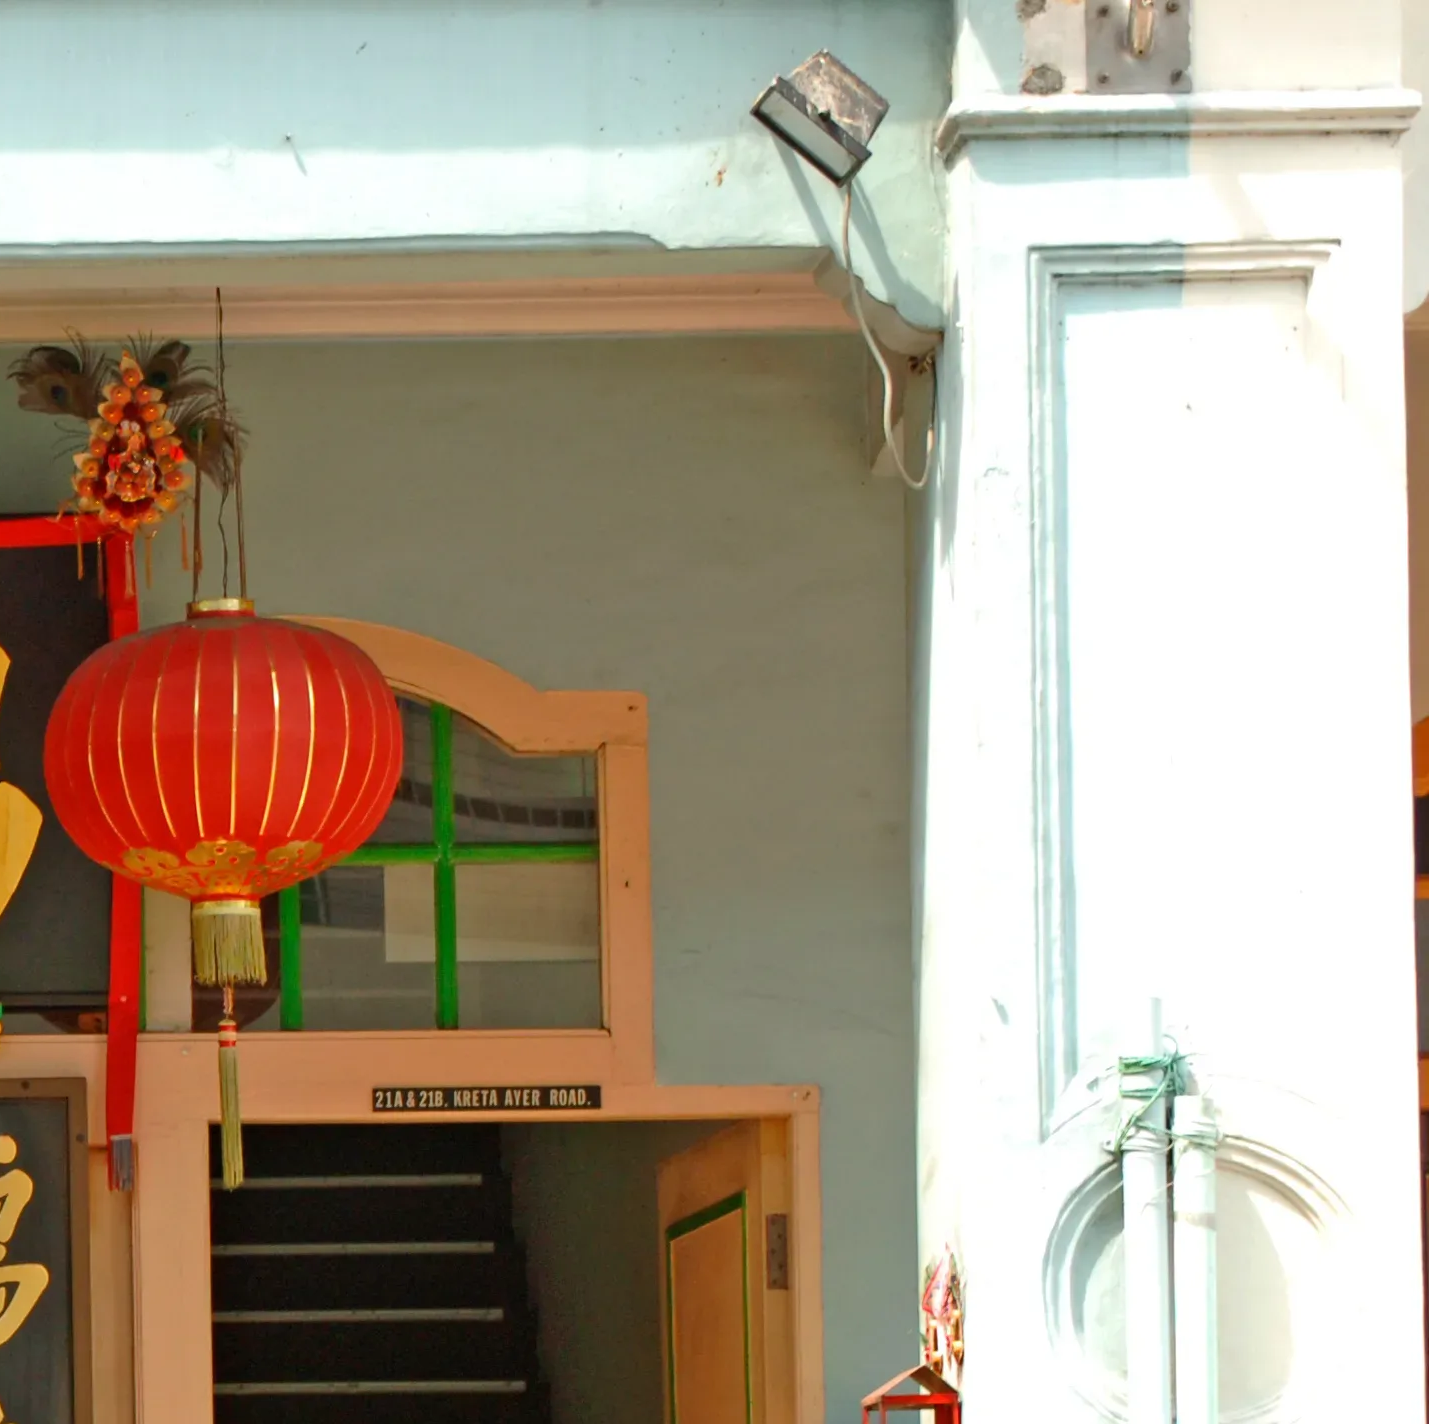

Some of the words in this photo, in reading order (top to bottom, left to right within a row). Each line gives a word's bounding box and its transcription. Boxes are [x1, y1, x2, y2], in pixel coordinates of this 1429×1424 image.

[375, 1091, 403, 1108] 21A
[406, 1091, 416, 1107] &
[453, 1089, 498, 1107] KRETA
[504, 1088, 540, 1107] AYER
[549, 1088, 592, 1107] ROAD.
